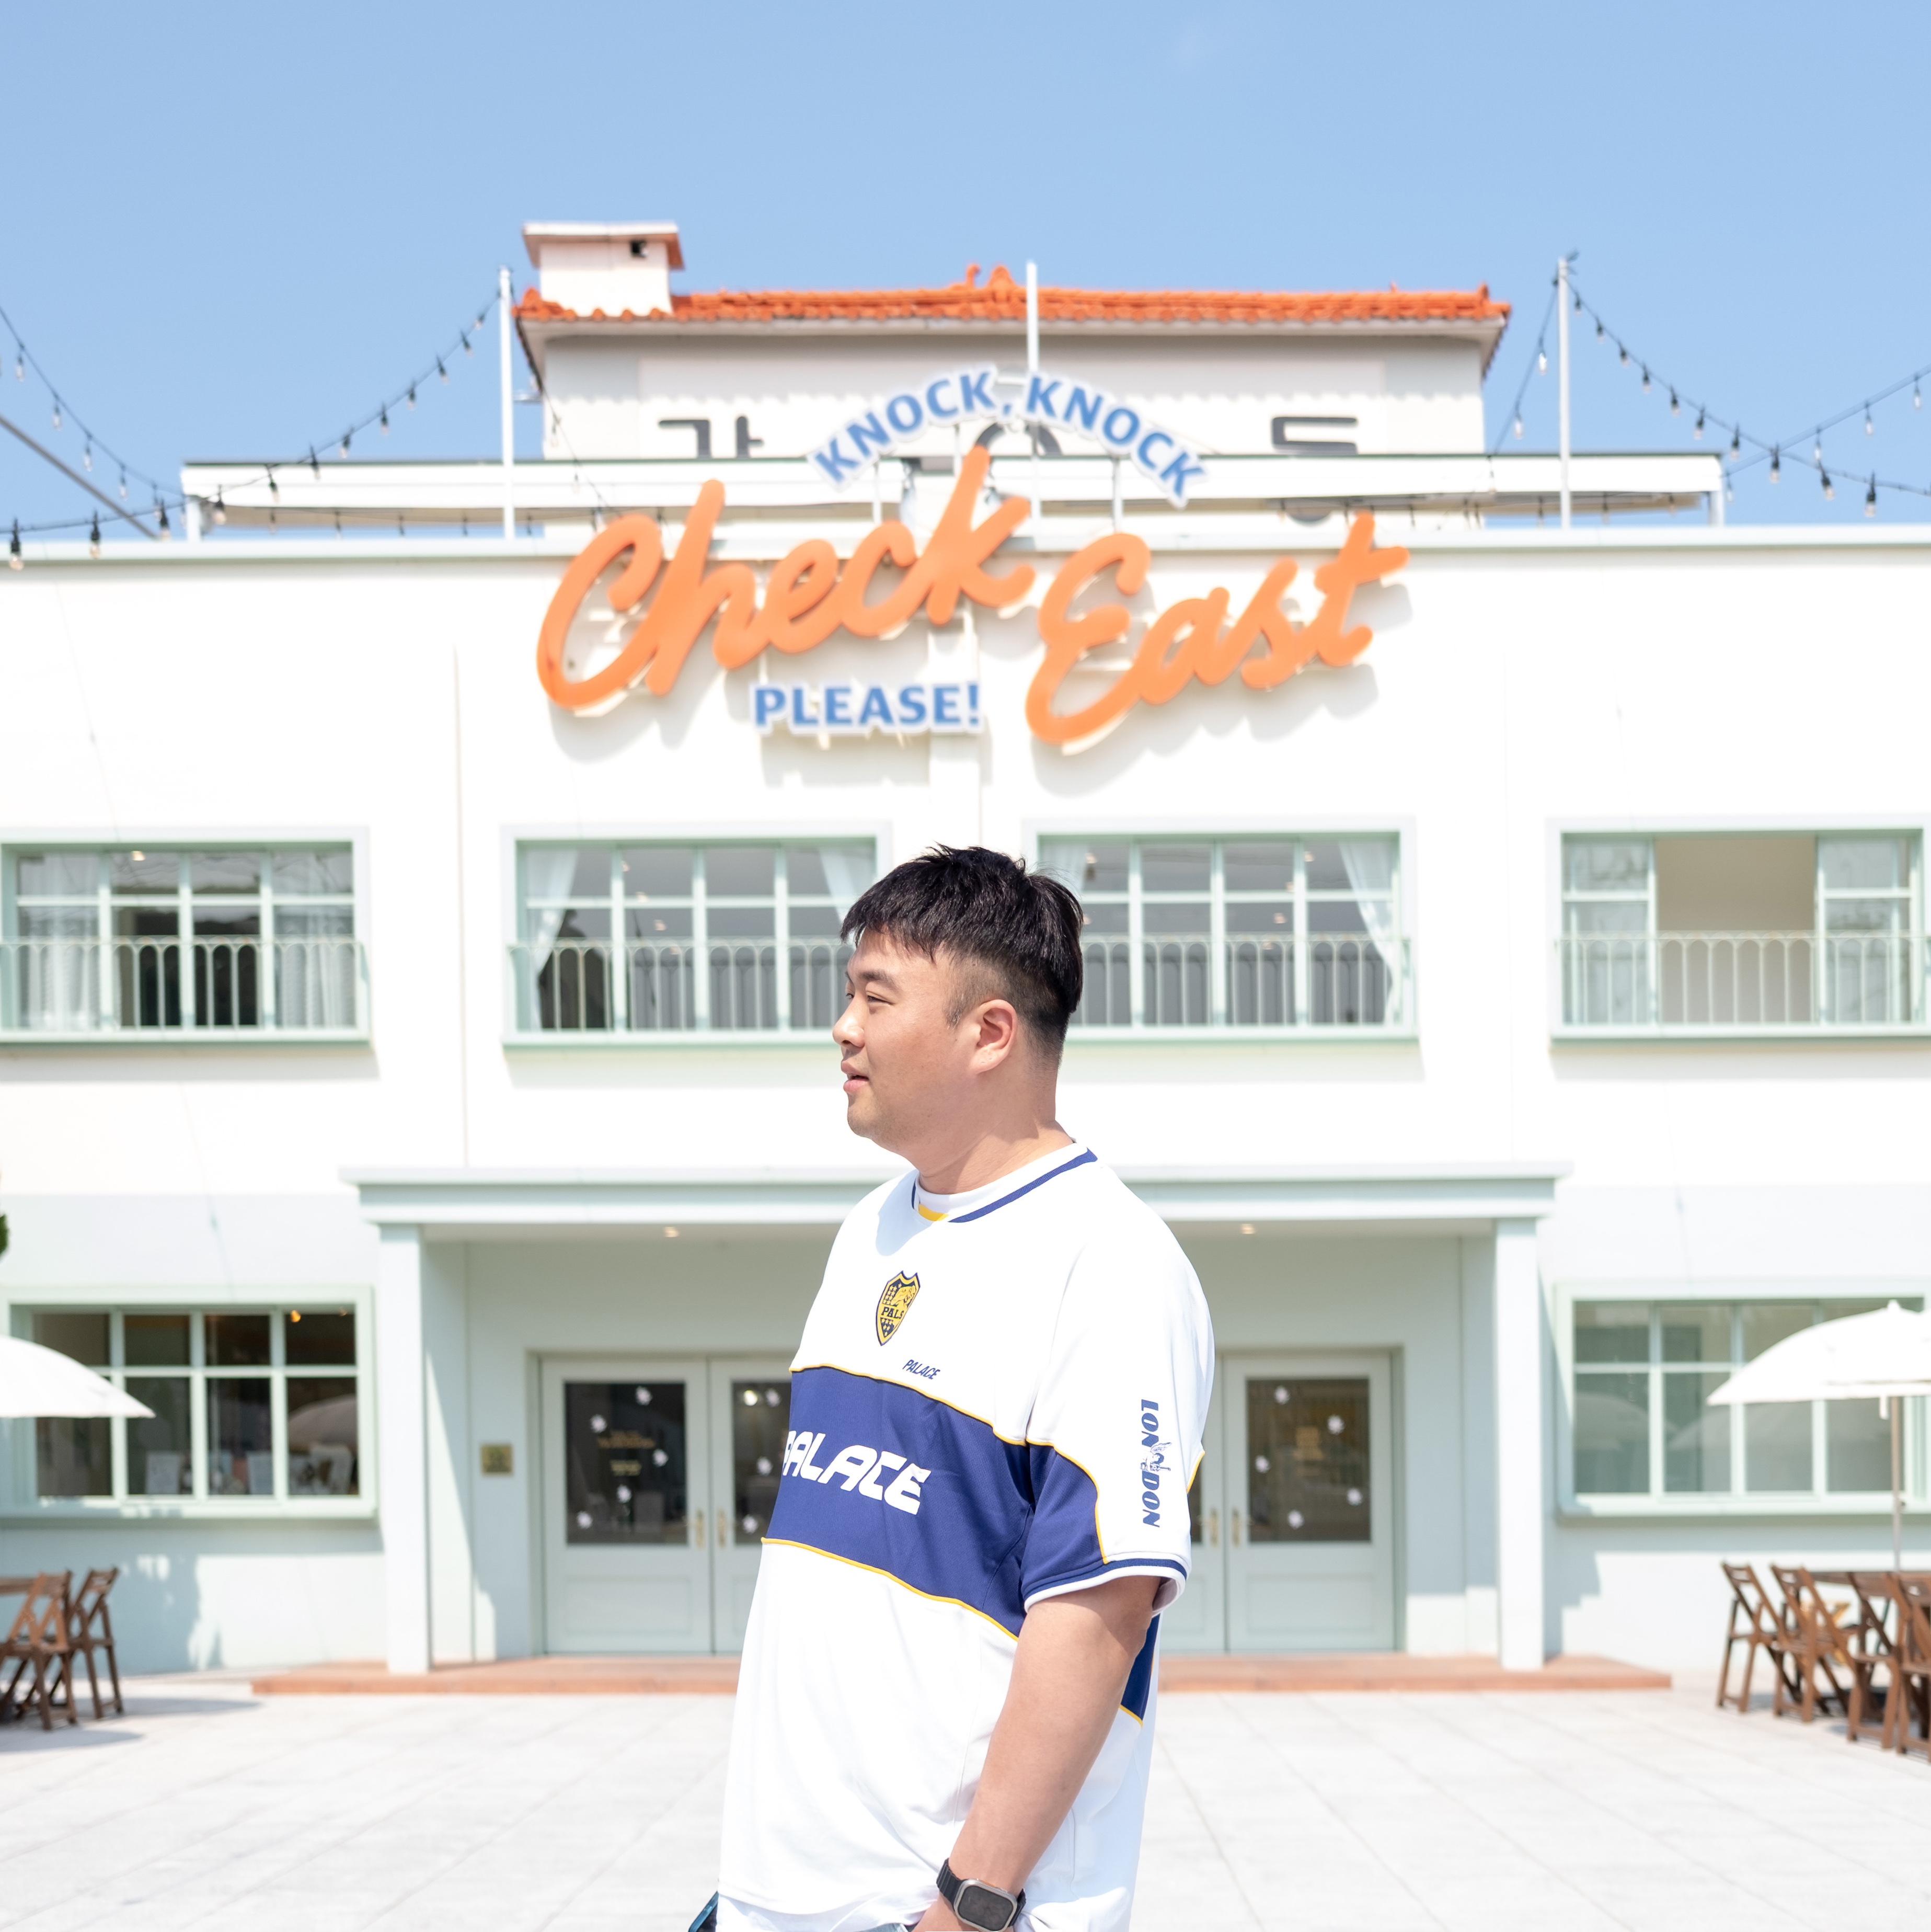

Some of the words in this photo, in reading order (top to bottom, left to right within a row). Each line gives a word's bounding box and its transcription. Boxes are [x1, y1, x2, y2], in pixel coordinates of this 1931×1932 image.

[814, 372, 1012, 483] KNOCK,
[1025, 376, 1204, 497] KNOCK
[536, 445, 1035, 710] Check
[1026, 511, 1410, 745] East
[754, 683, 979, 726] PLEASE!
[902, 1359, 941, 1380] PALACE
[783, 1430, 932, 1515] PALACE
